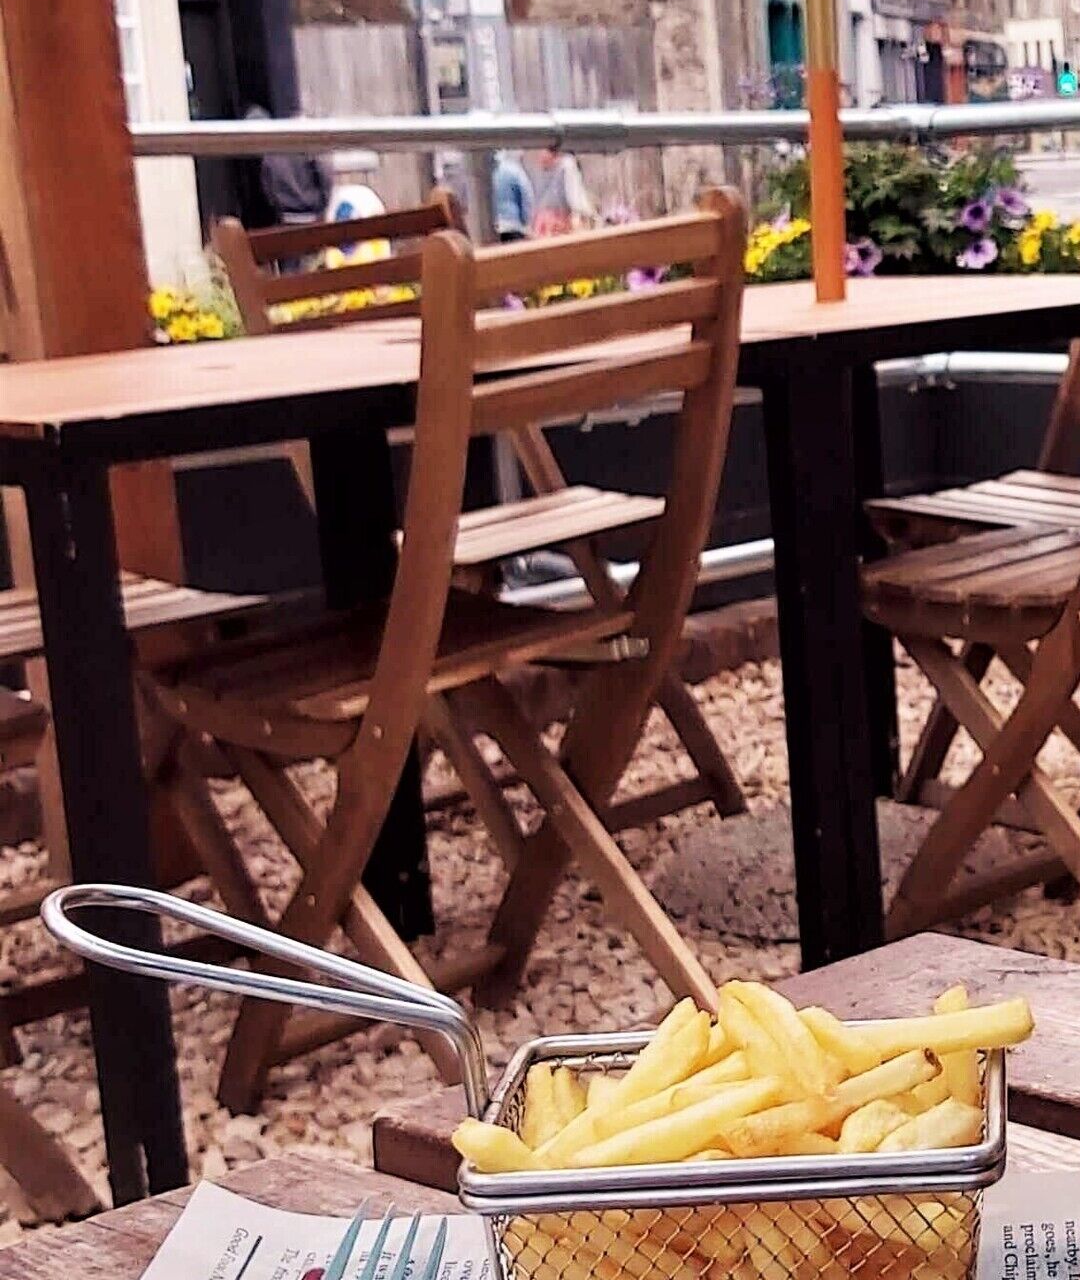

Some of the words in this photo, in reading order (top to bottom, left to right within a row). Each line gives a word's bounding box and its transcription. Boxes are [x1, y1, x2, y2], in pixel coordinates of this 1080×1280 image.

[1003, 1225, 1018, 1250] and
[1041, 1222, 1057, 1259] goes,
[1064, 1221, 1080, 1270] nearby.
[1046, 1260, 1061, 1277] he
